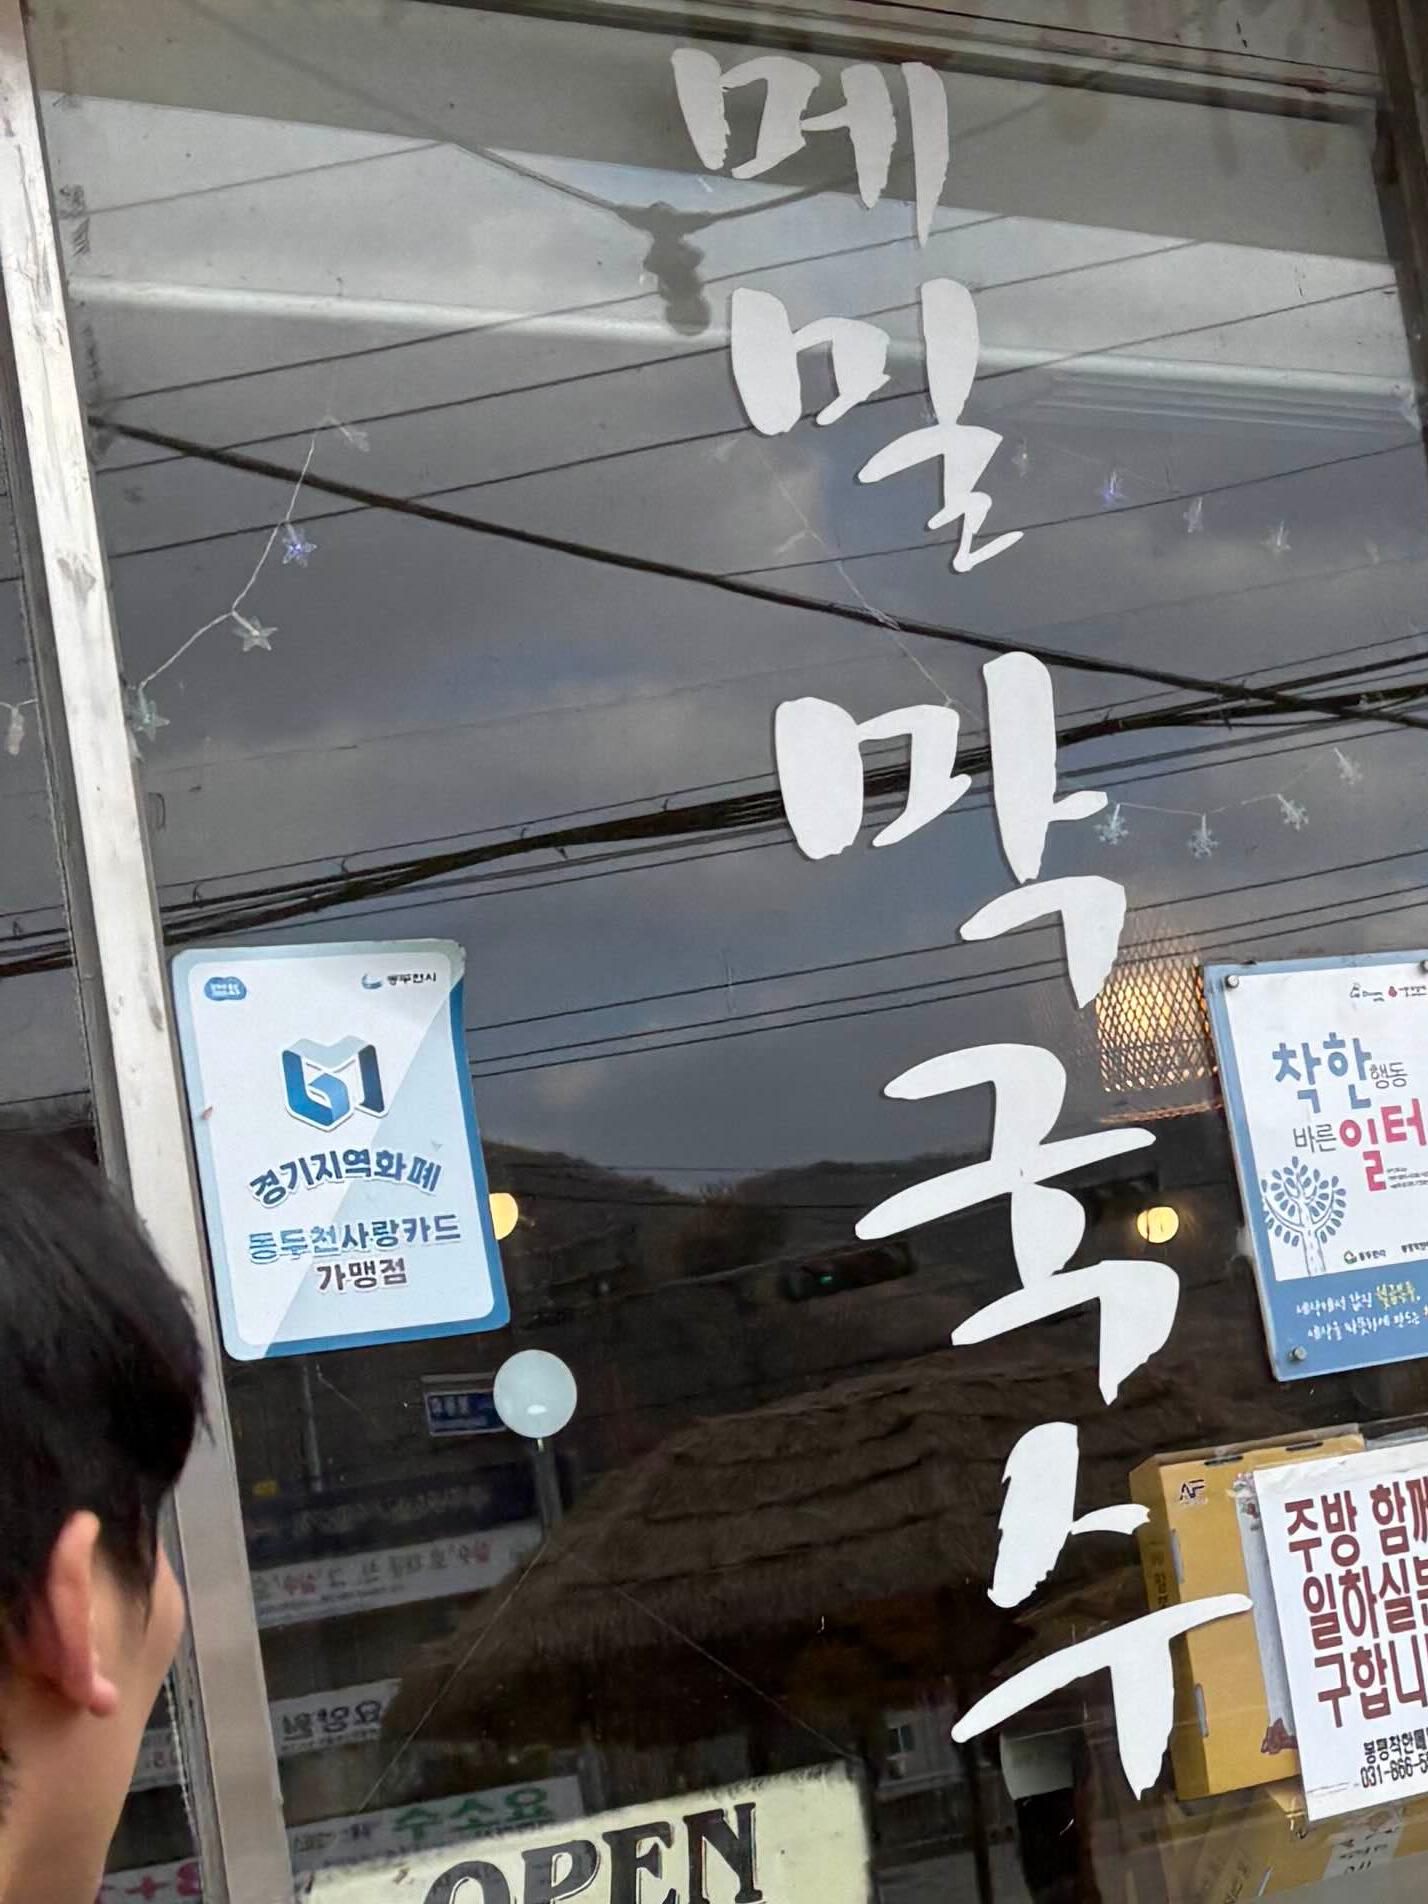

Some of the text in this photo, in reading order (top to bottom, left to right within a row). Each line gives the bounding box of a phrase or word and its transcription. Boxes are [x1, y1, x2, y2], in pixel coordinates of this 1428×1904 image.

[667, 46, 1257, 1800] 메밀 막국수
[1272, 1031, 1409, 1114] 착한 행동
[248, 1148, 444, 1207] 경기지역화폐
[1292, 1097, 1428, 1193] 바른 일터
[248, 1214, 462, 1265] 동두천사랑카드
[315, 1257, 409, 1294] 가맹점
[1284, 1489, 1362, 1573] 주방
